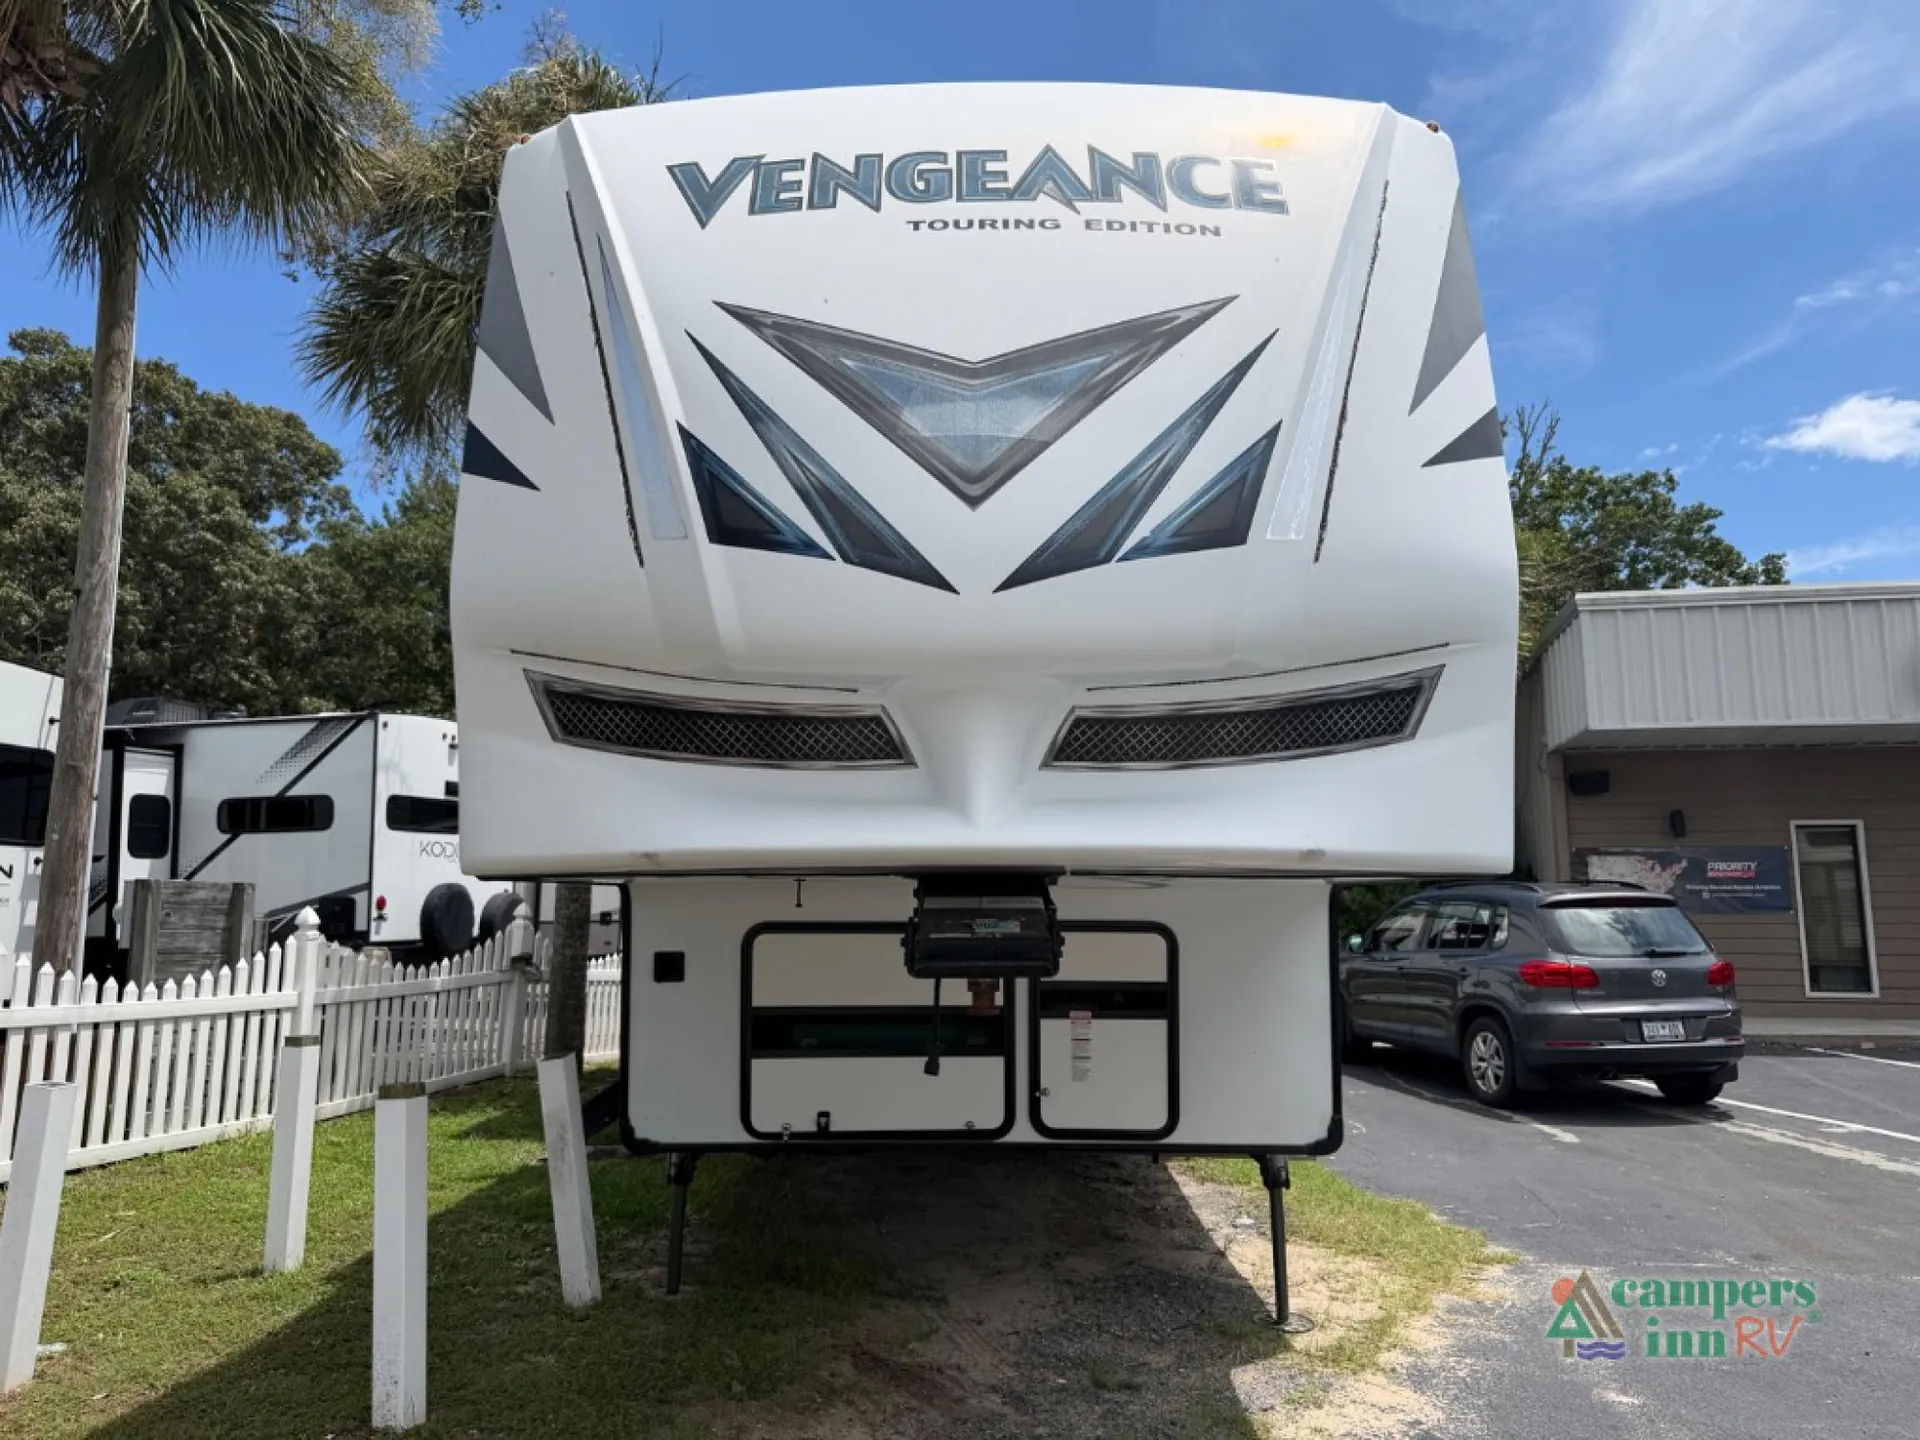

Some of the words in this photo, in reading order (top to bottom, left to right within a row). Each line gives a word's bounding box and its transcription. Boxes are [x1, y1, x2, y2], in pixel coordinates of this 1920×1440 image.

[665, 143, 1290, 230] VENGEANCE
[906, 218, 1062, 232] TOURING
[1084, 218, 1222, 238] EDITION
[1707, 861, 1758, 872] PRIORITY
